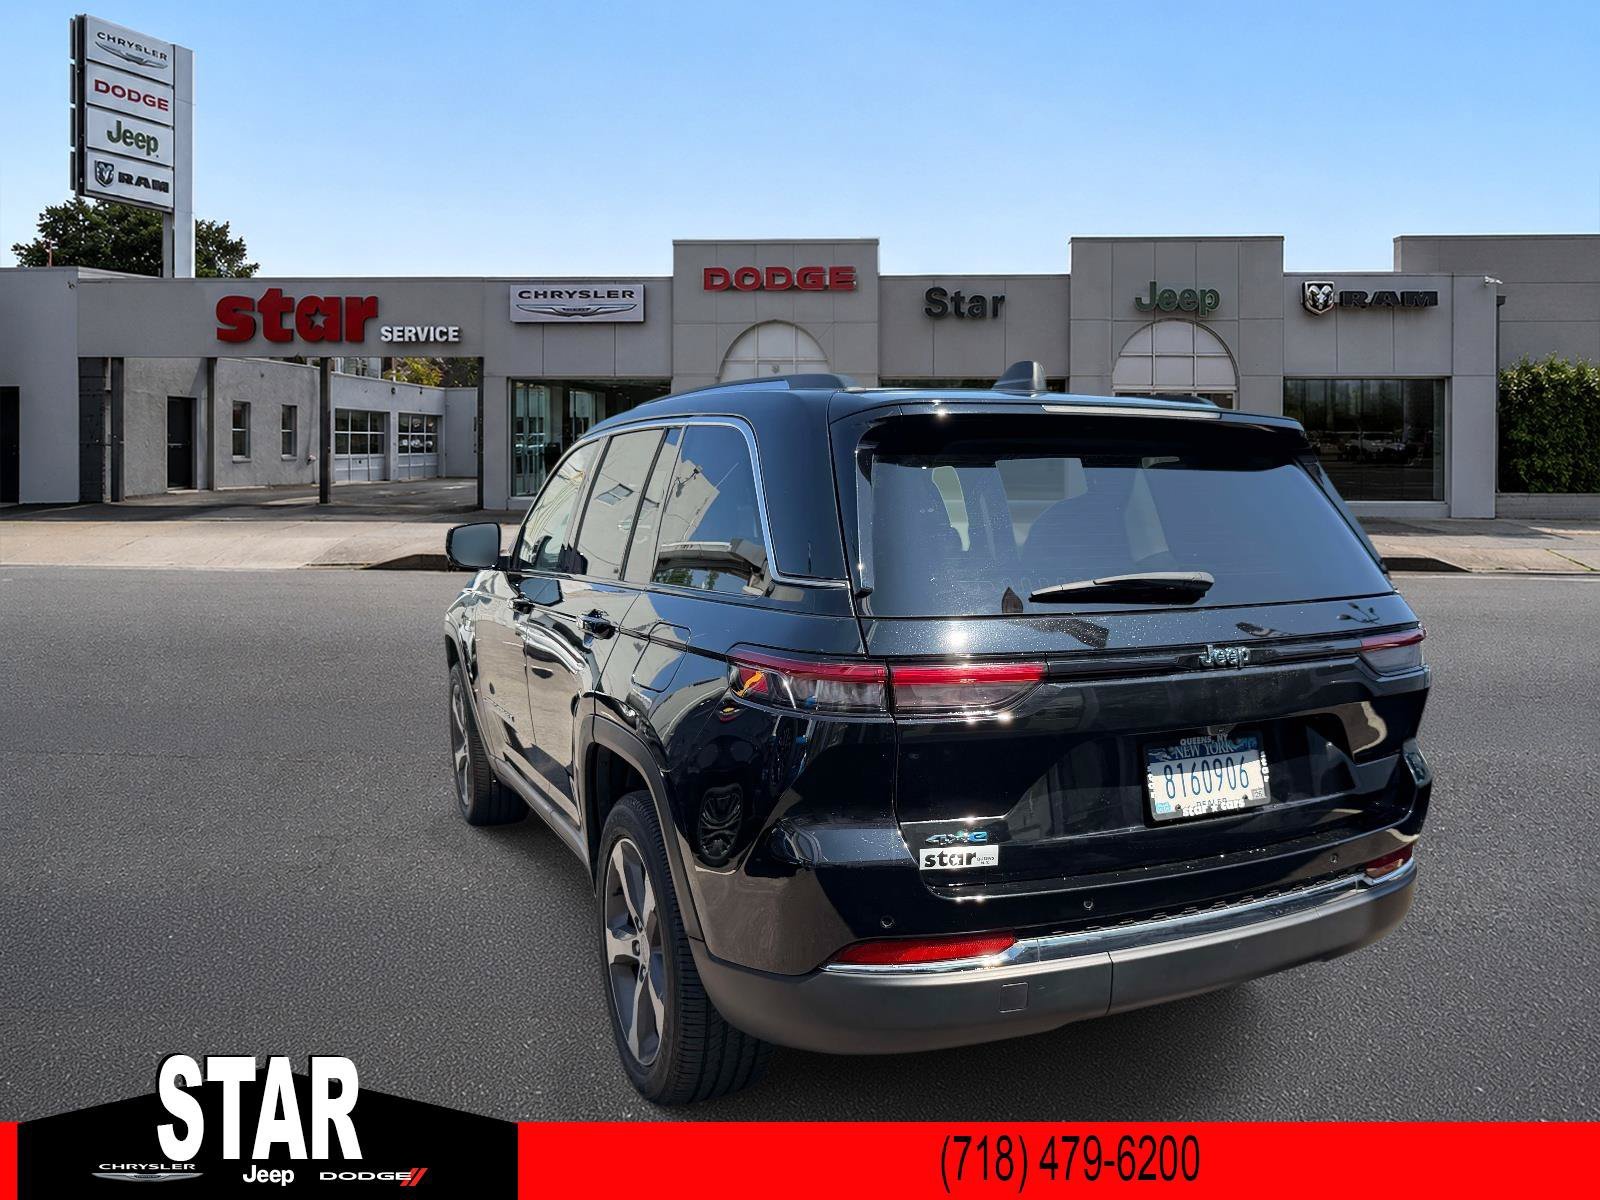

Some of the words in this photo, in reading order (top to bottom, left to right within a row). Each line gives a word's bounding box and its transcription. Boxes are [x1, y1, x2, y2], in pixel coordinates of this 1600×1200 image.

[97, 31, 168, 61] CHRYSLER
[94, 79, 169, 111] DODGE
[107, 120, 159, 156] Jeep
[118, 171, 169, 194] RAM
[704, 266, 857, 291] DODGE
[518, 290, 635, 299] CHRYSLER
[924, 287, 1005, 319] Star
[1135, 281, 1219, 316] Jeep
[1339, 290, 1438, 307] RAM
[216, 288, 378, 343] star
[380, 326, 460, 343] SERVICE
[1199, 644, 1250, 668] Jeep
[1175, 743, 1200, 759] NEW
[1203, 736, 1234, 756] YORK
[1163, 755, 1249, 799] 8160906
[924, 851, 976, 867] star
